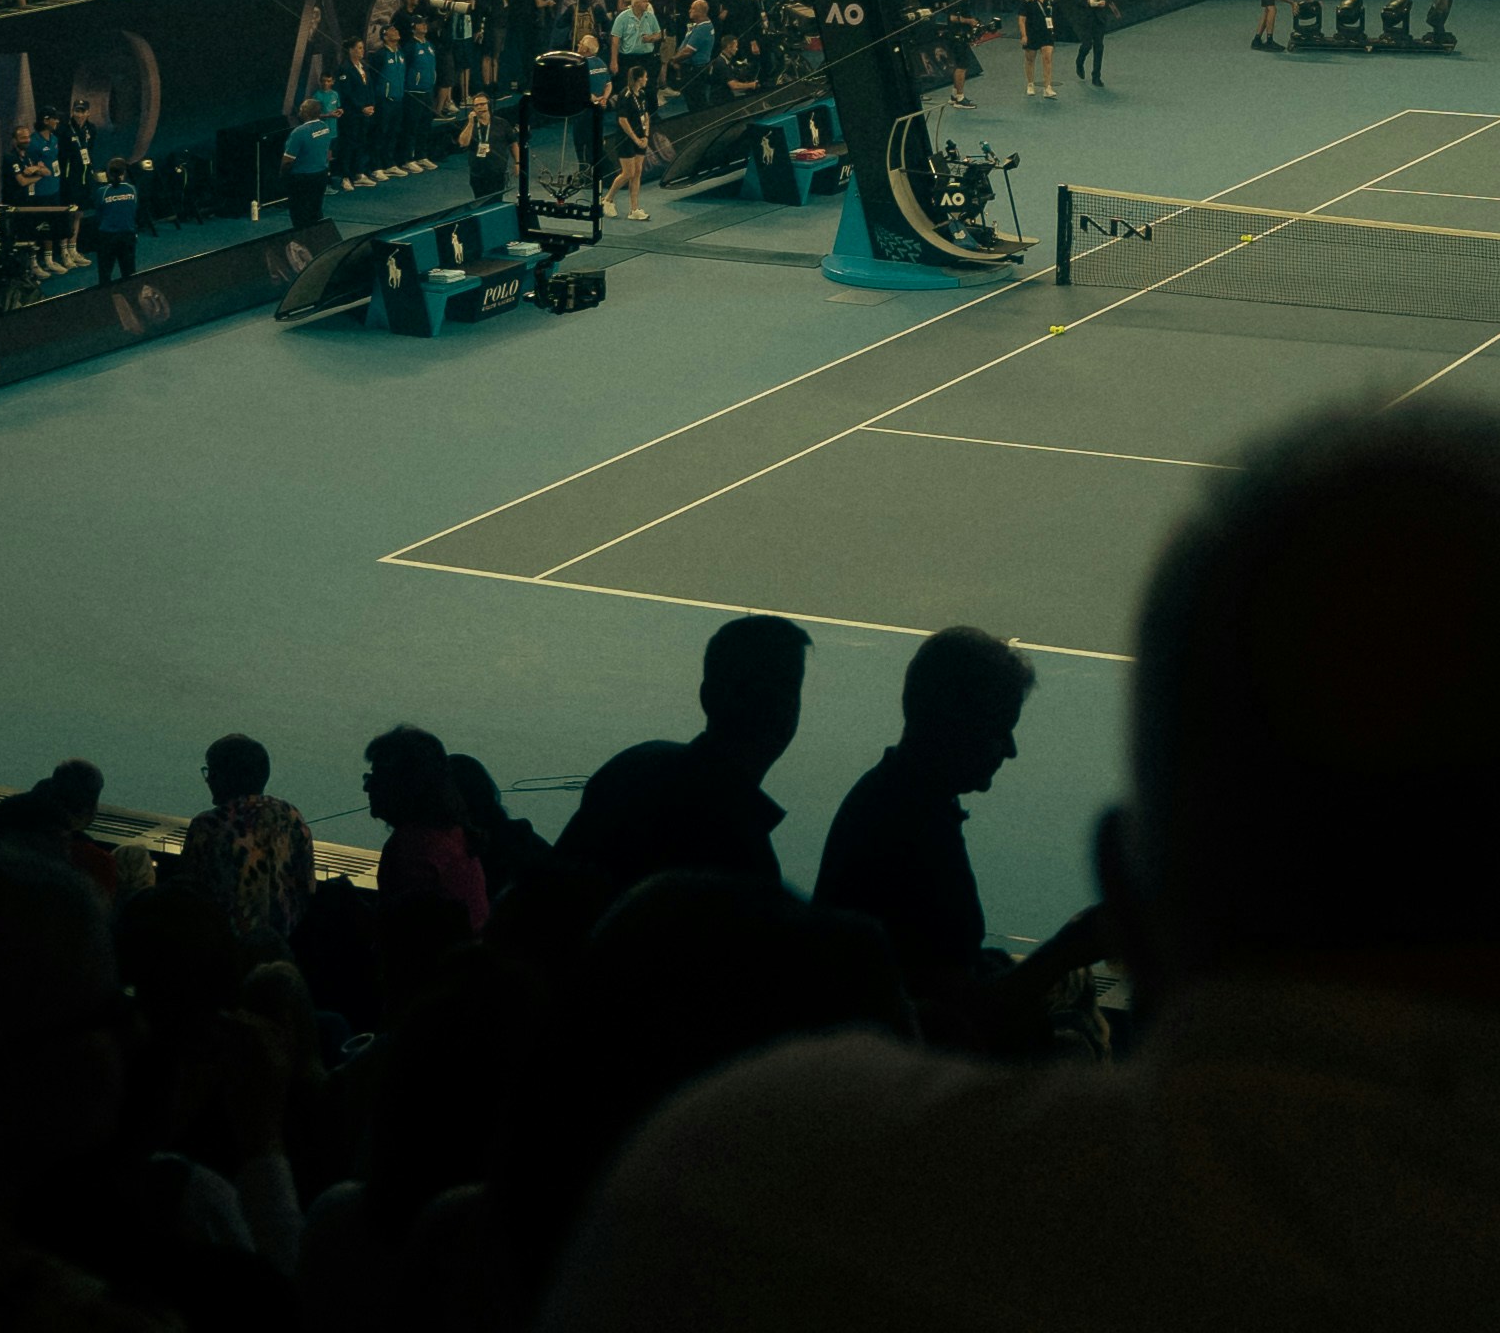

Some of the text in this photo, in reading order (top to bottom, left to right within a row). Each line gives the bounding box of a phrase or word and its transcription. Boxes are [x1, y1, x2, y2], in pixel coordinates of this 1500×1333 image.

[825, 2, 865, 26] AO
[105, 193, 135, 204] SECURITY
[940, 193, 965, 206] AO
[483, 278, 520, 306] POLO
